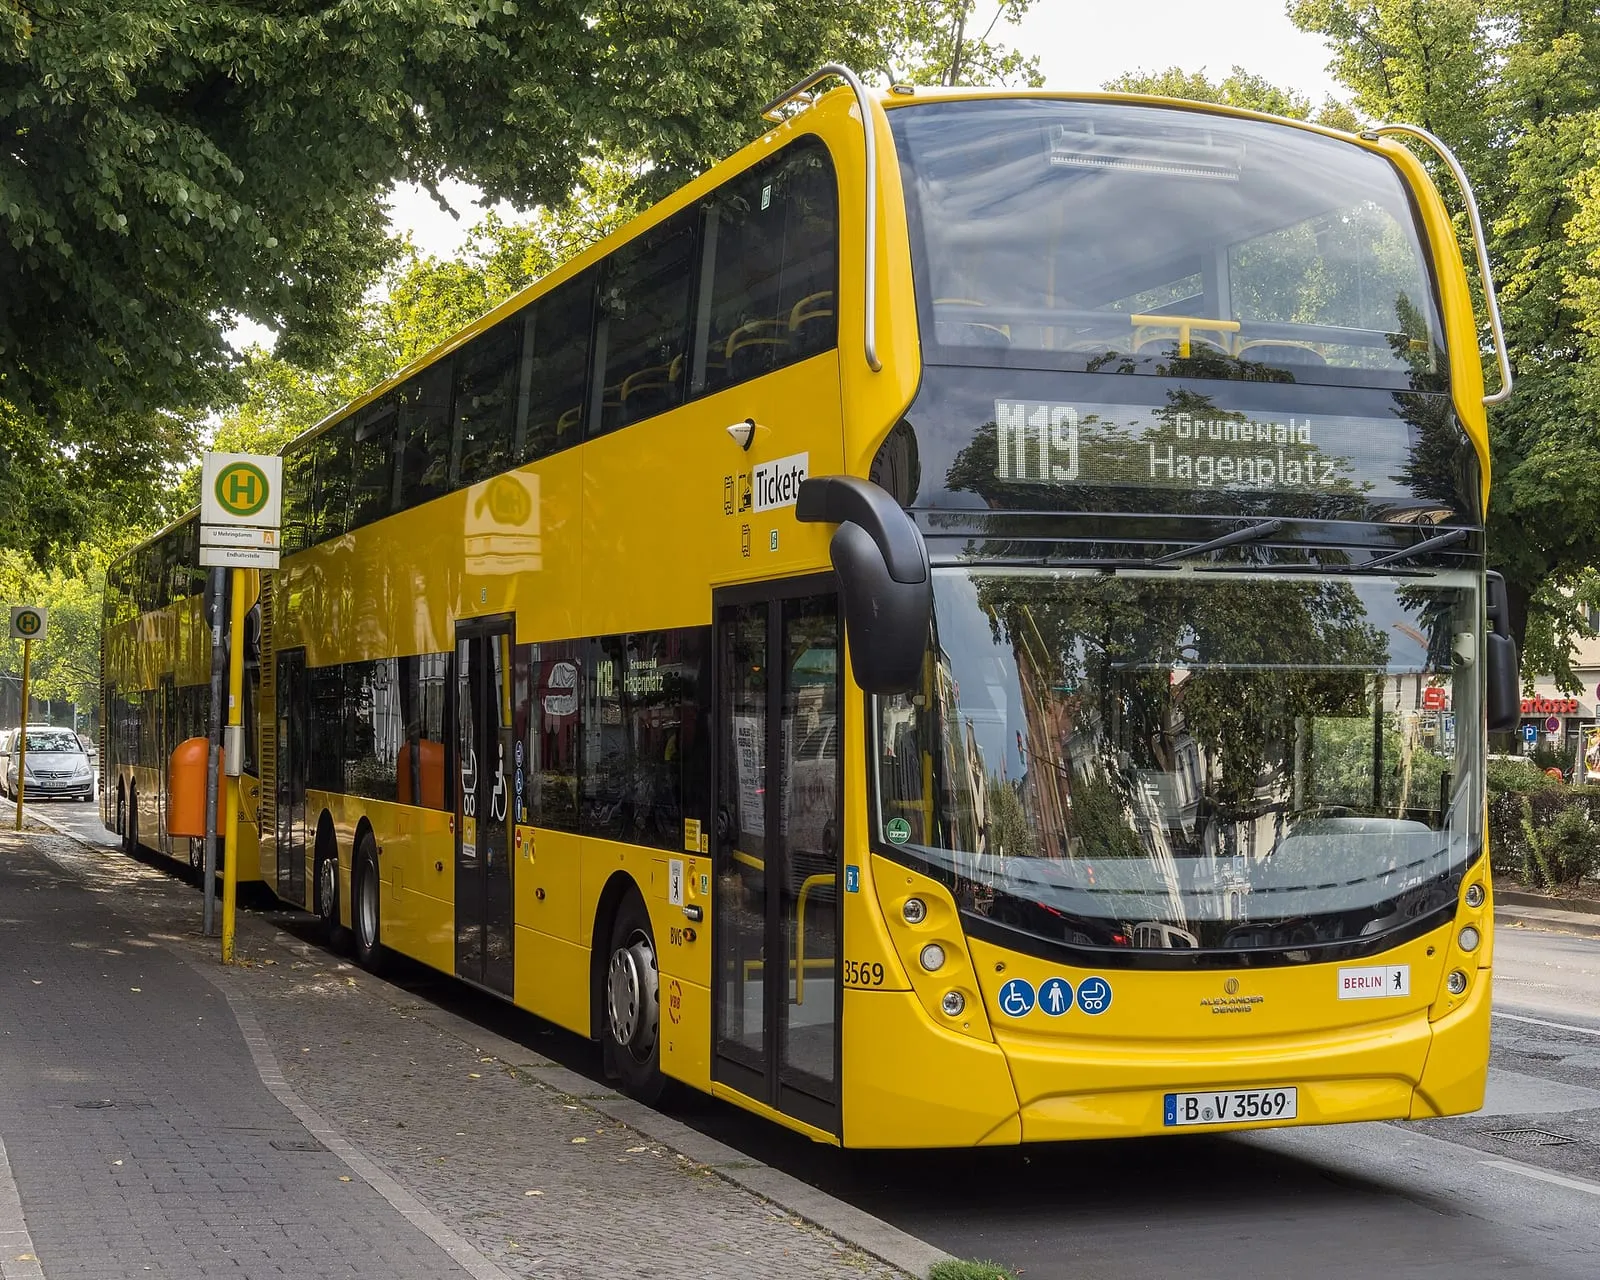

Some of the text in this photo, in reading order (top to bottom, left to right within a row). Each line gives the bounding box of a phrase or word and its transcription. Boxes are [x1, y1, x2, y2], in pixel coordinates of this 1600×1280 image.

[1175, 412, 1311, 445] Grunewald
[997, 403, 1079, 481] M19
[1148, 444, 1335, 489] Hagenplatz
[229, 474, 255, 504] H
[623, 672, 664, 695] Hagenplatz
[1520, 694, 1577, 713] arkasse
[1526, 728, 1534, 740] P
[895, 819, 902, 831] 4
[670, 927, 682, 946] BVG
[845, 960, 884, 985] 3569
[1344, 976, 1382, 989] BERLIN
[1200, 996, 1264, 1006] ALEXANDER
[1212, 1006, 1252, 1014] DENNIS
[1185, 1092, 1286, 1120] B V 3569
[1167, 1112, 1174, 1120] D
